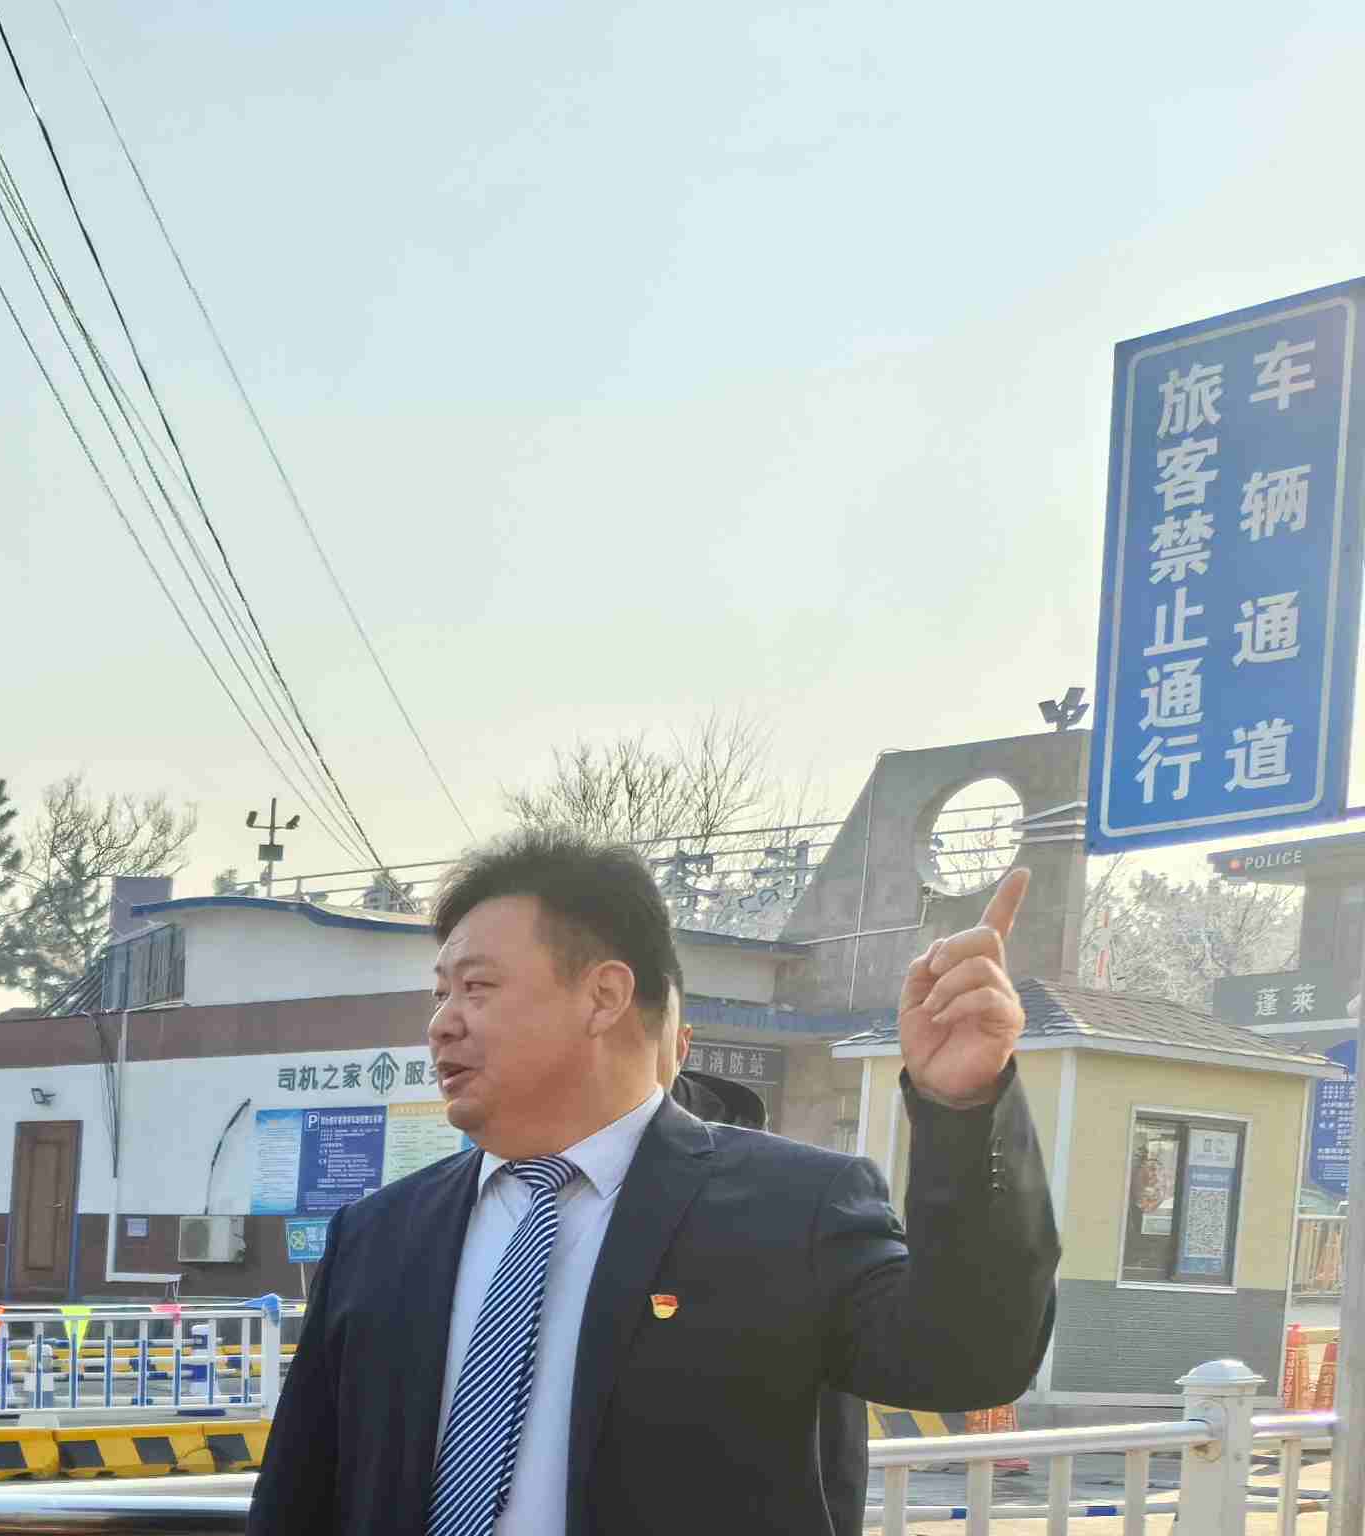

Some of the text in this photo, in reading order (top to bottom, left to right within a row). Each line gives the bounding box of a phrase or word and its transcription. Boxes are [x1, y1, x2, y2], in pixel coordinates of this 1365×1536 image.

[1136, 362, 1224, 805] 旅客禁止通行
[1224, 339, 1317, 793] 车辆通道
[1245, 850, 1302, 871] POLICE
[277, 1063, 362, 1091] 司机之家
